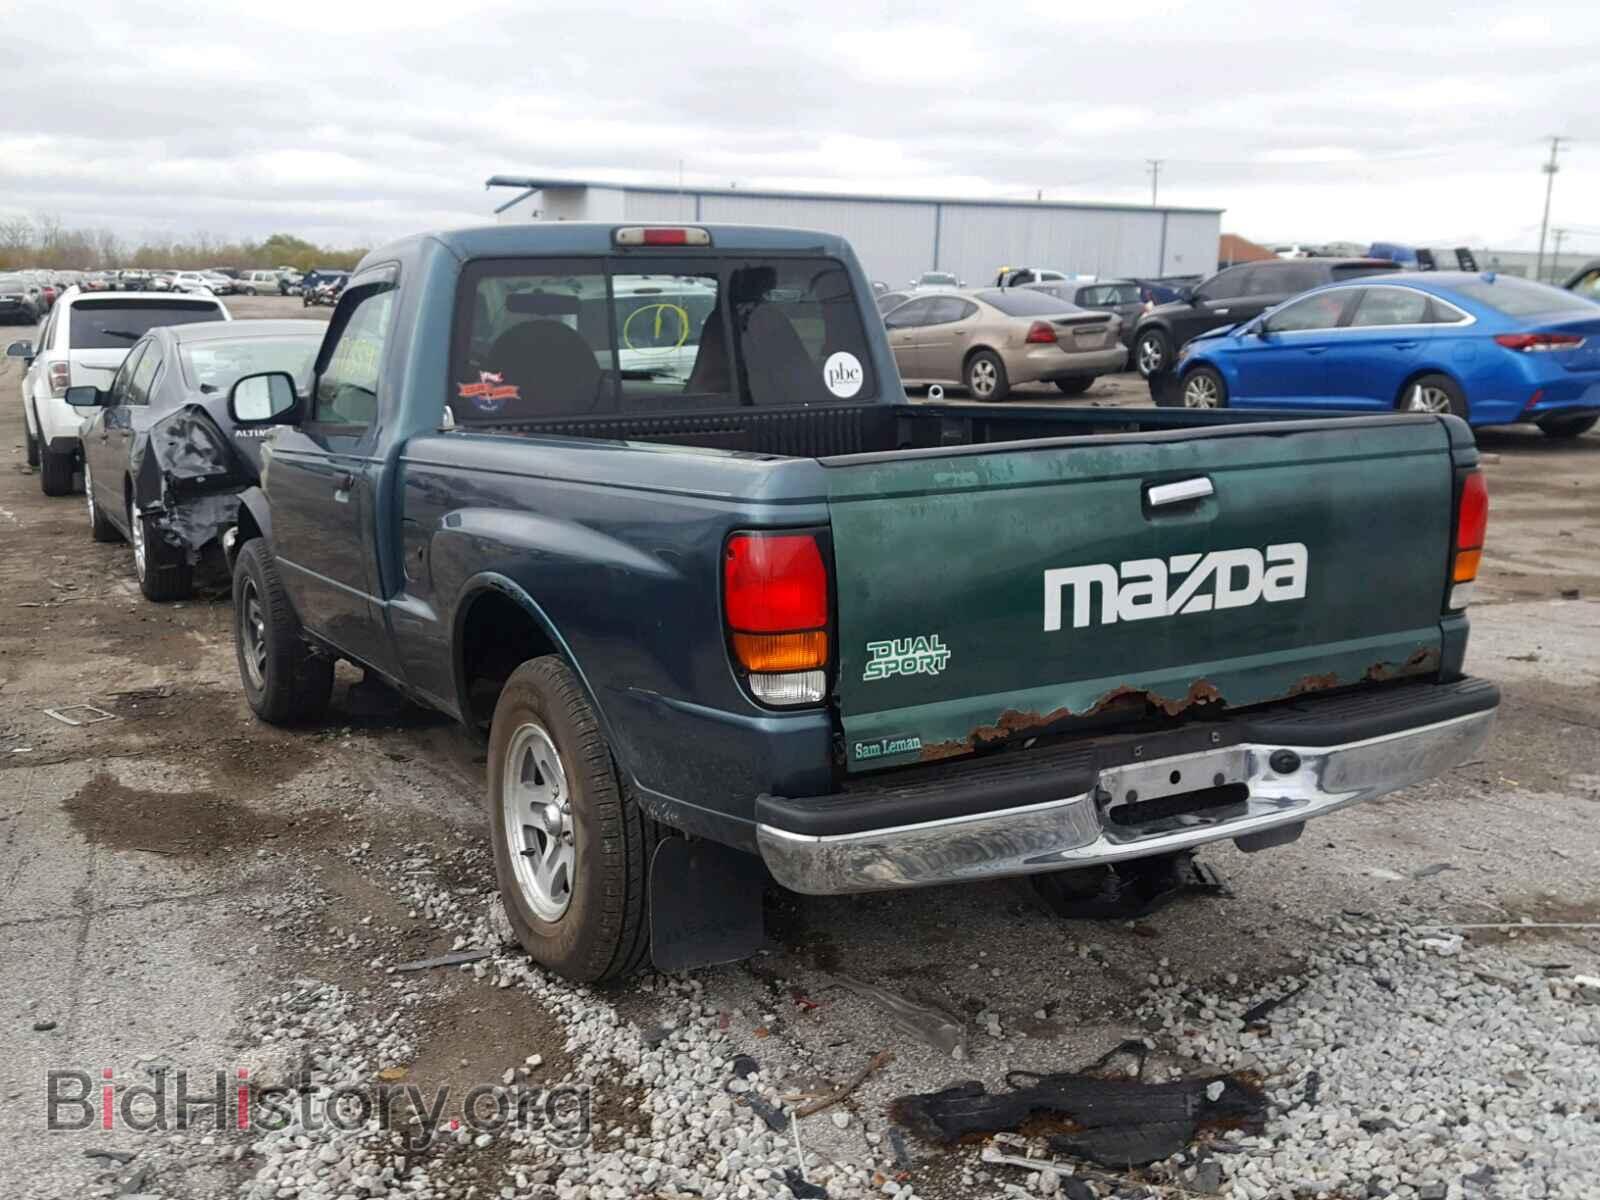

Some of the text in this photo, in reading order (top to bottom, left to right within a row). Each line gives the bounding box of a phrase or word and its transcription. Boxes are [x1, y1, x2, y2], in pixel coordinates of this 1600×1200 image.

[829, 361, 859, 388] pbc
[235, 429, 266, 437] ALTIM
[866, 634, 947, 661] DUAL
[863, 650, 952, 681] SPORT
[855, 737, 921, 759] Sam Leman
